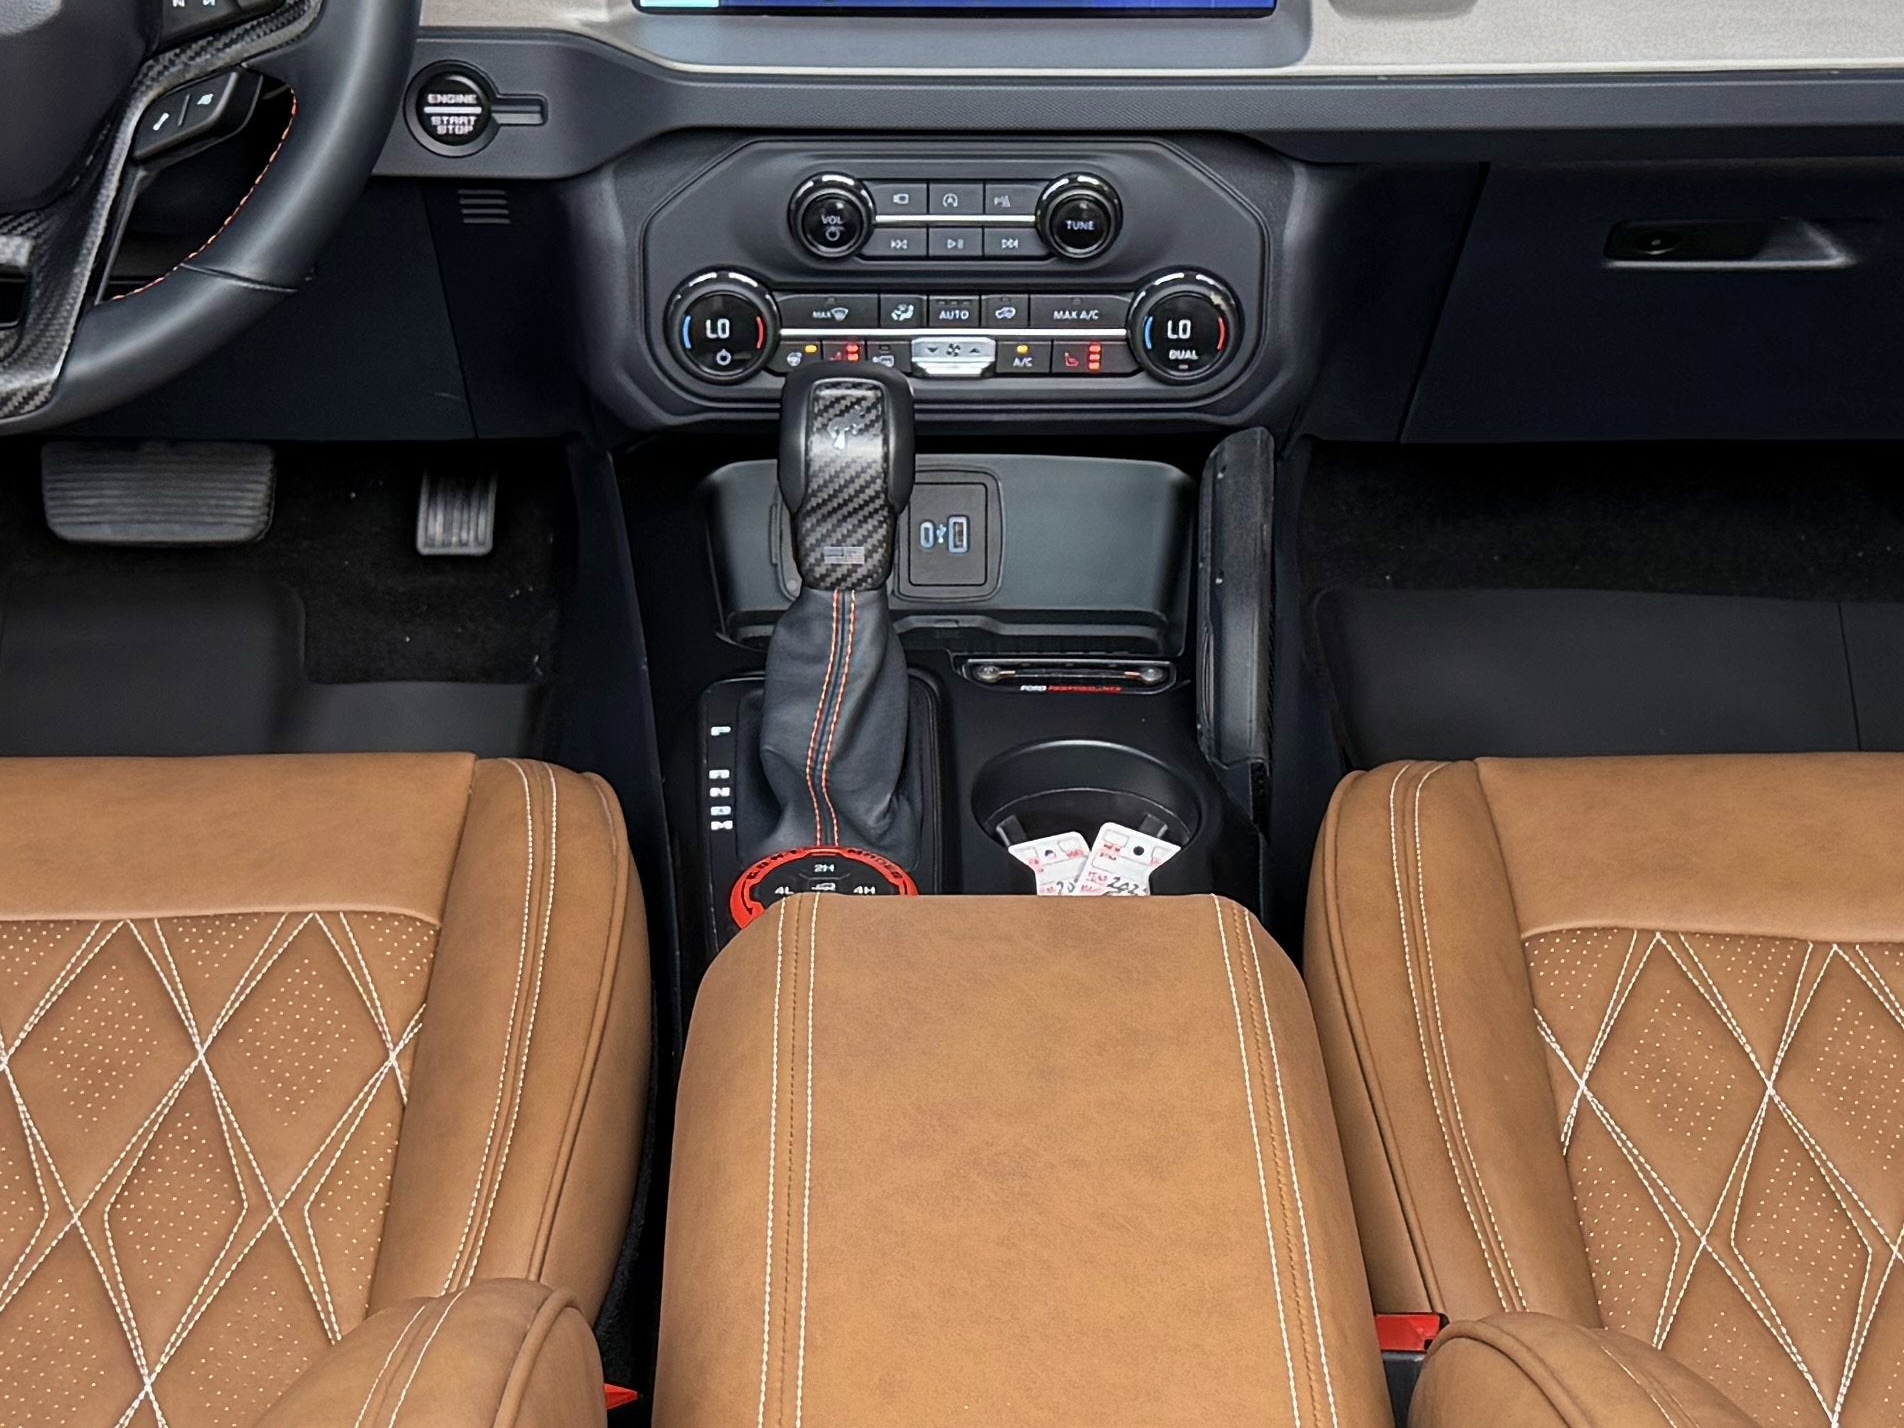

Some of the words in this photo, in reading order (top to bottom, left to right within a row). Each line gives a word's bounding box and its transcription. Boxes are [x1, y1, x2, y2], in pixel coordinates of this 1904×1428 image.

[427, 93, 478, 105] ENGINE
[430, 115, 477, 126] START
[436, 125, 475, 135] STOP
[820, 214, 843, 225] VOL
[1066, 220, 1094, 231] TUNE
[939, 309, 969, 320] AUTO
[1053, 310, 1078, 320] MAX
[1079, 309, 1100, 321] A/C
[706, 318, 730, 340] LO
[1167, 319, 1192, 340] LO
[1169, 349, 1198, 360] DUAL
[1012, 357, 1033, 368] A/C
[814, 863, 835, 873] 2H
[853, 885, 877, 895] 4H
